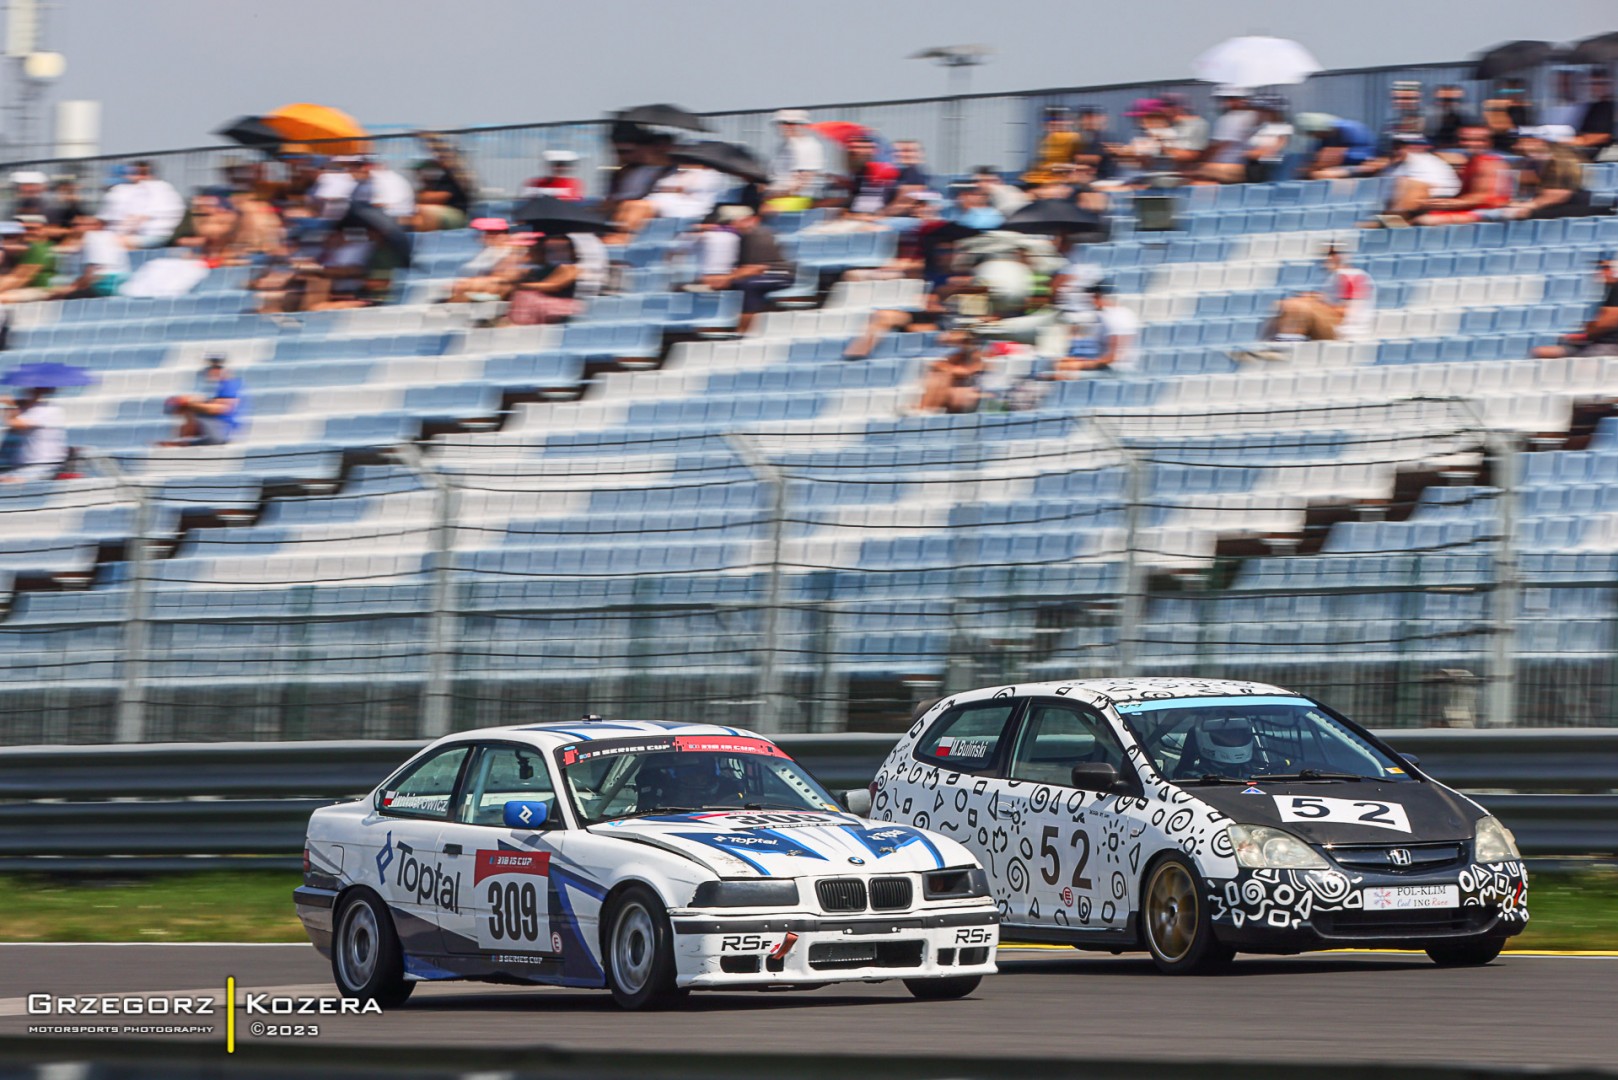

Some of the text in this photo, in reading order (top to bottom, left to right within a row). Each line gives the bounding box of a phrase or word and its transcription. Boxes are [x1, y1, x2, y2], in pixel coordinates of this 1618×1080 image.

[725, 814, 832, 825] 309
[1292, 798, 1396, 825] 52
[726, 836, 779, 846] Toptal
[1041, 825, 1093, 890] 52
[397, 840, 461, 914] Toptal
[1397, 885, 1446, 896] POL-KLIM
[488, 881, 539, 942] 309
[529, 956, 543, 964] CUP
